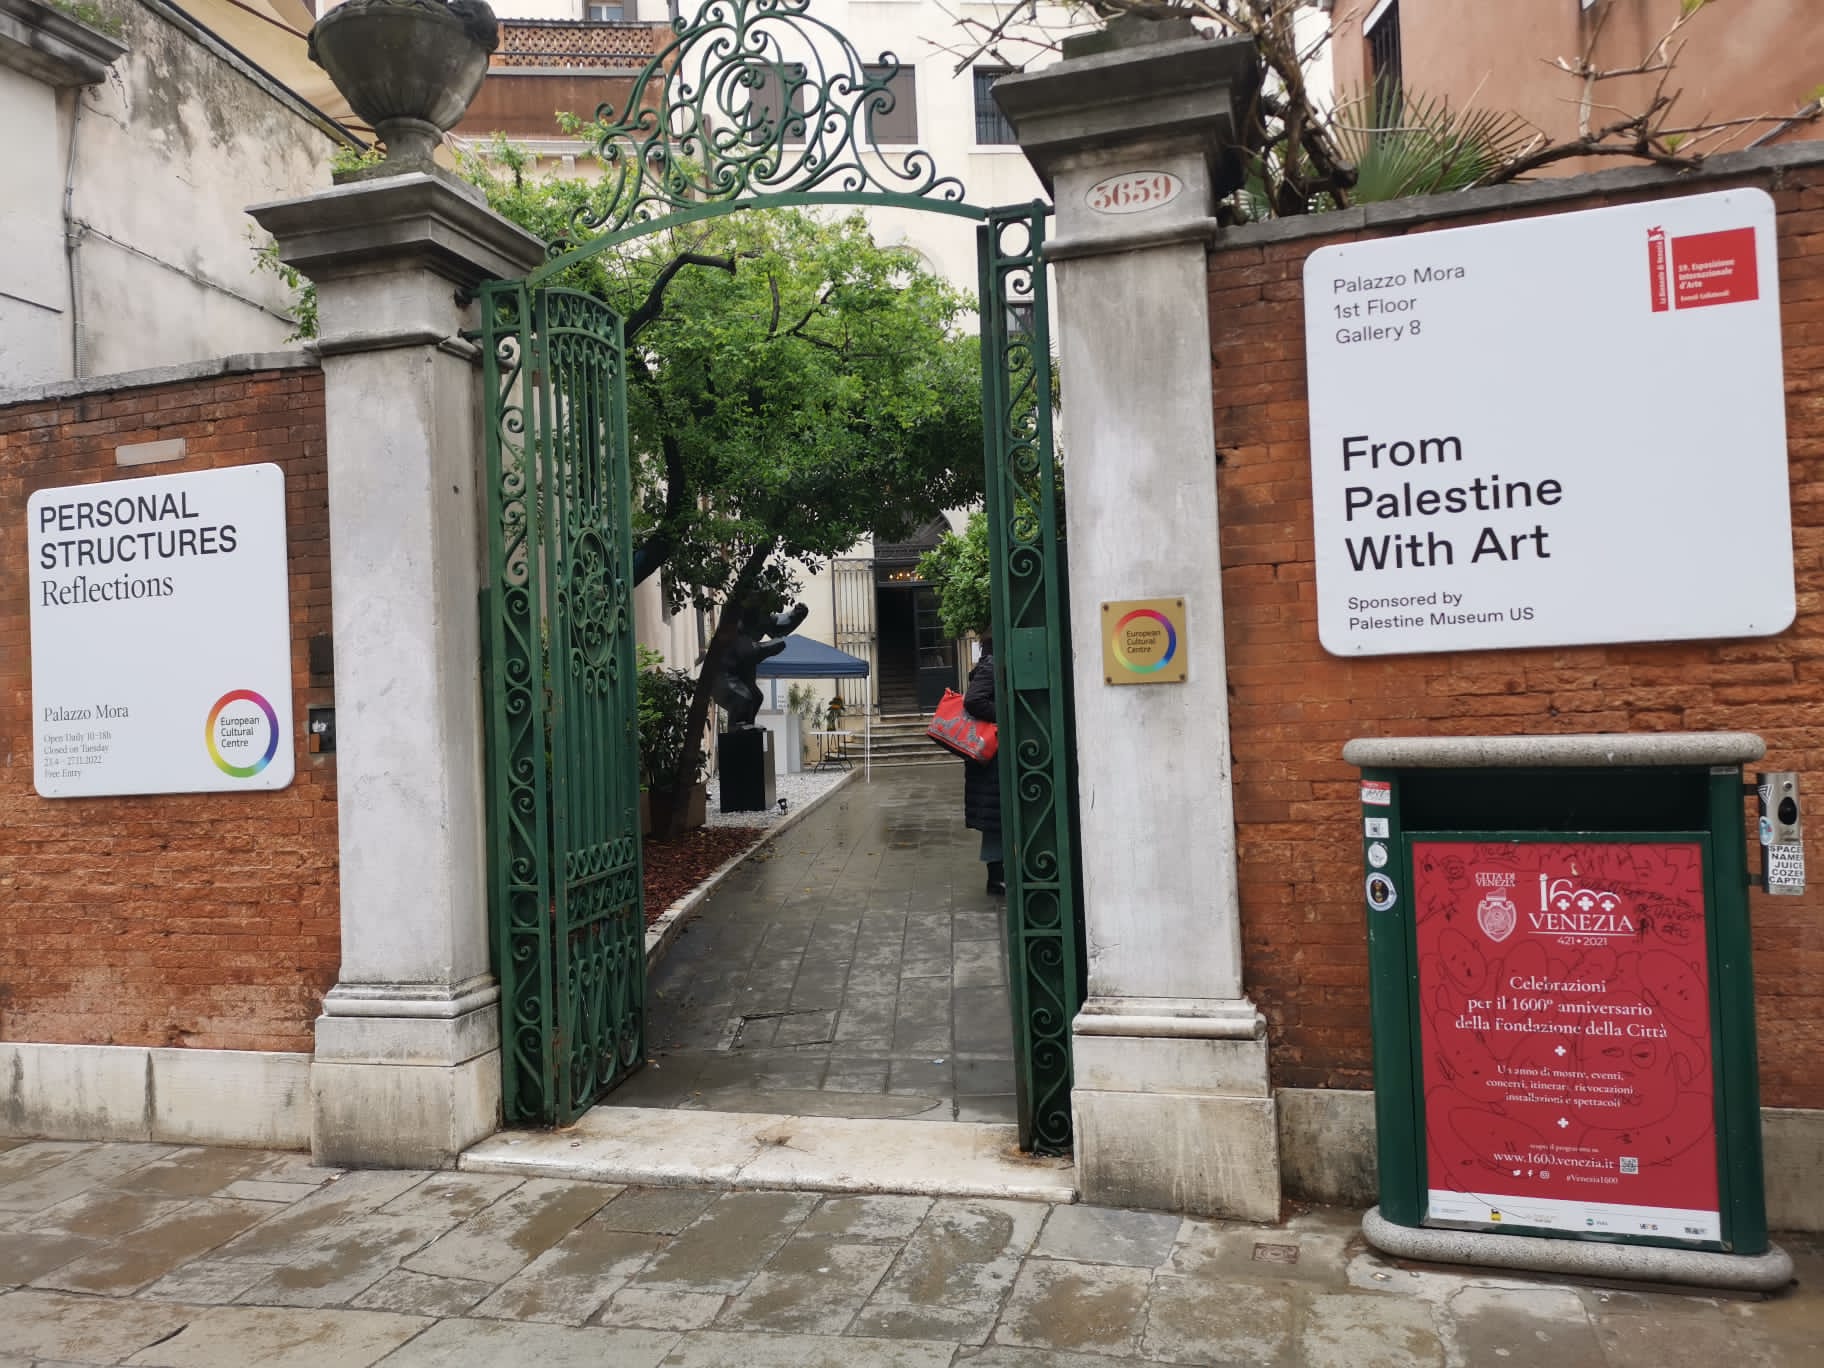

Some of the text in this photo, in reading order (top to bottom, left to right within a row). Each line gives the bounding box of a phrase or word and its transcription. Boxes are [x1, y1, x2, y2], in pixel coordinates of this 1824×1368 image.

[1094, 175, 1172, 208] 3659
[1333, 266, 1465, 294] Palazzo Mora
[1334, 298, 1417, 319] 1st Floor
[1335, 319, 1421, 344] Gallery 8
[1343, 435, 1462, 471] From
[1345, 474, 1562, 521] Palestine
[40, 491, 199, 534] PERSONAL
[40, 525, 238, 570] STRUCTURES
[1345, 525, 1551, 571] With Art
[41, 573, 174, 607] Reflections
[1348, 591, 1462, 612] Sponsored by
[1350, 607, 1534, 631] Palestine Museum US
[1126, 630, 1161, 639] European
[44, 704, 129, 722] Palazzo Mora
[220, 717, 260, 727] European
[220, 727, 254, 738] Cultural
[221, 739, 249, 748] Centre
[1529, 913, 1634, 931] VENEZIA
[1510, 976, 1606, 993] Celebrazioni
[1468, 999, 1492, 1011] per
[1497, 997, 1507, 1009] il
[1558, 1000, 1652, 1016] anniversario
[1455, 1015, 1667, 1038] della Fondazione della Città
[1541, 1066, 1550, 1077] di
[1493, 1152, 1614, 1169] www.1600.venezia.it
